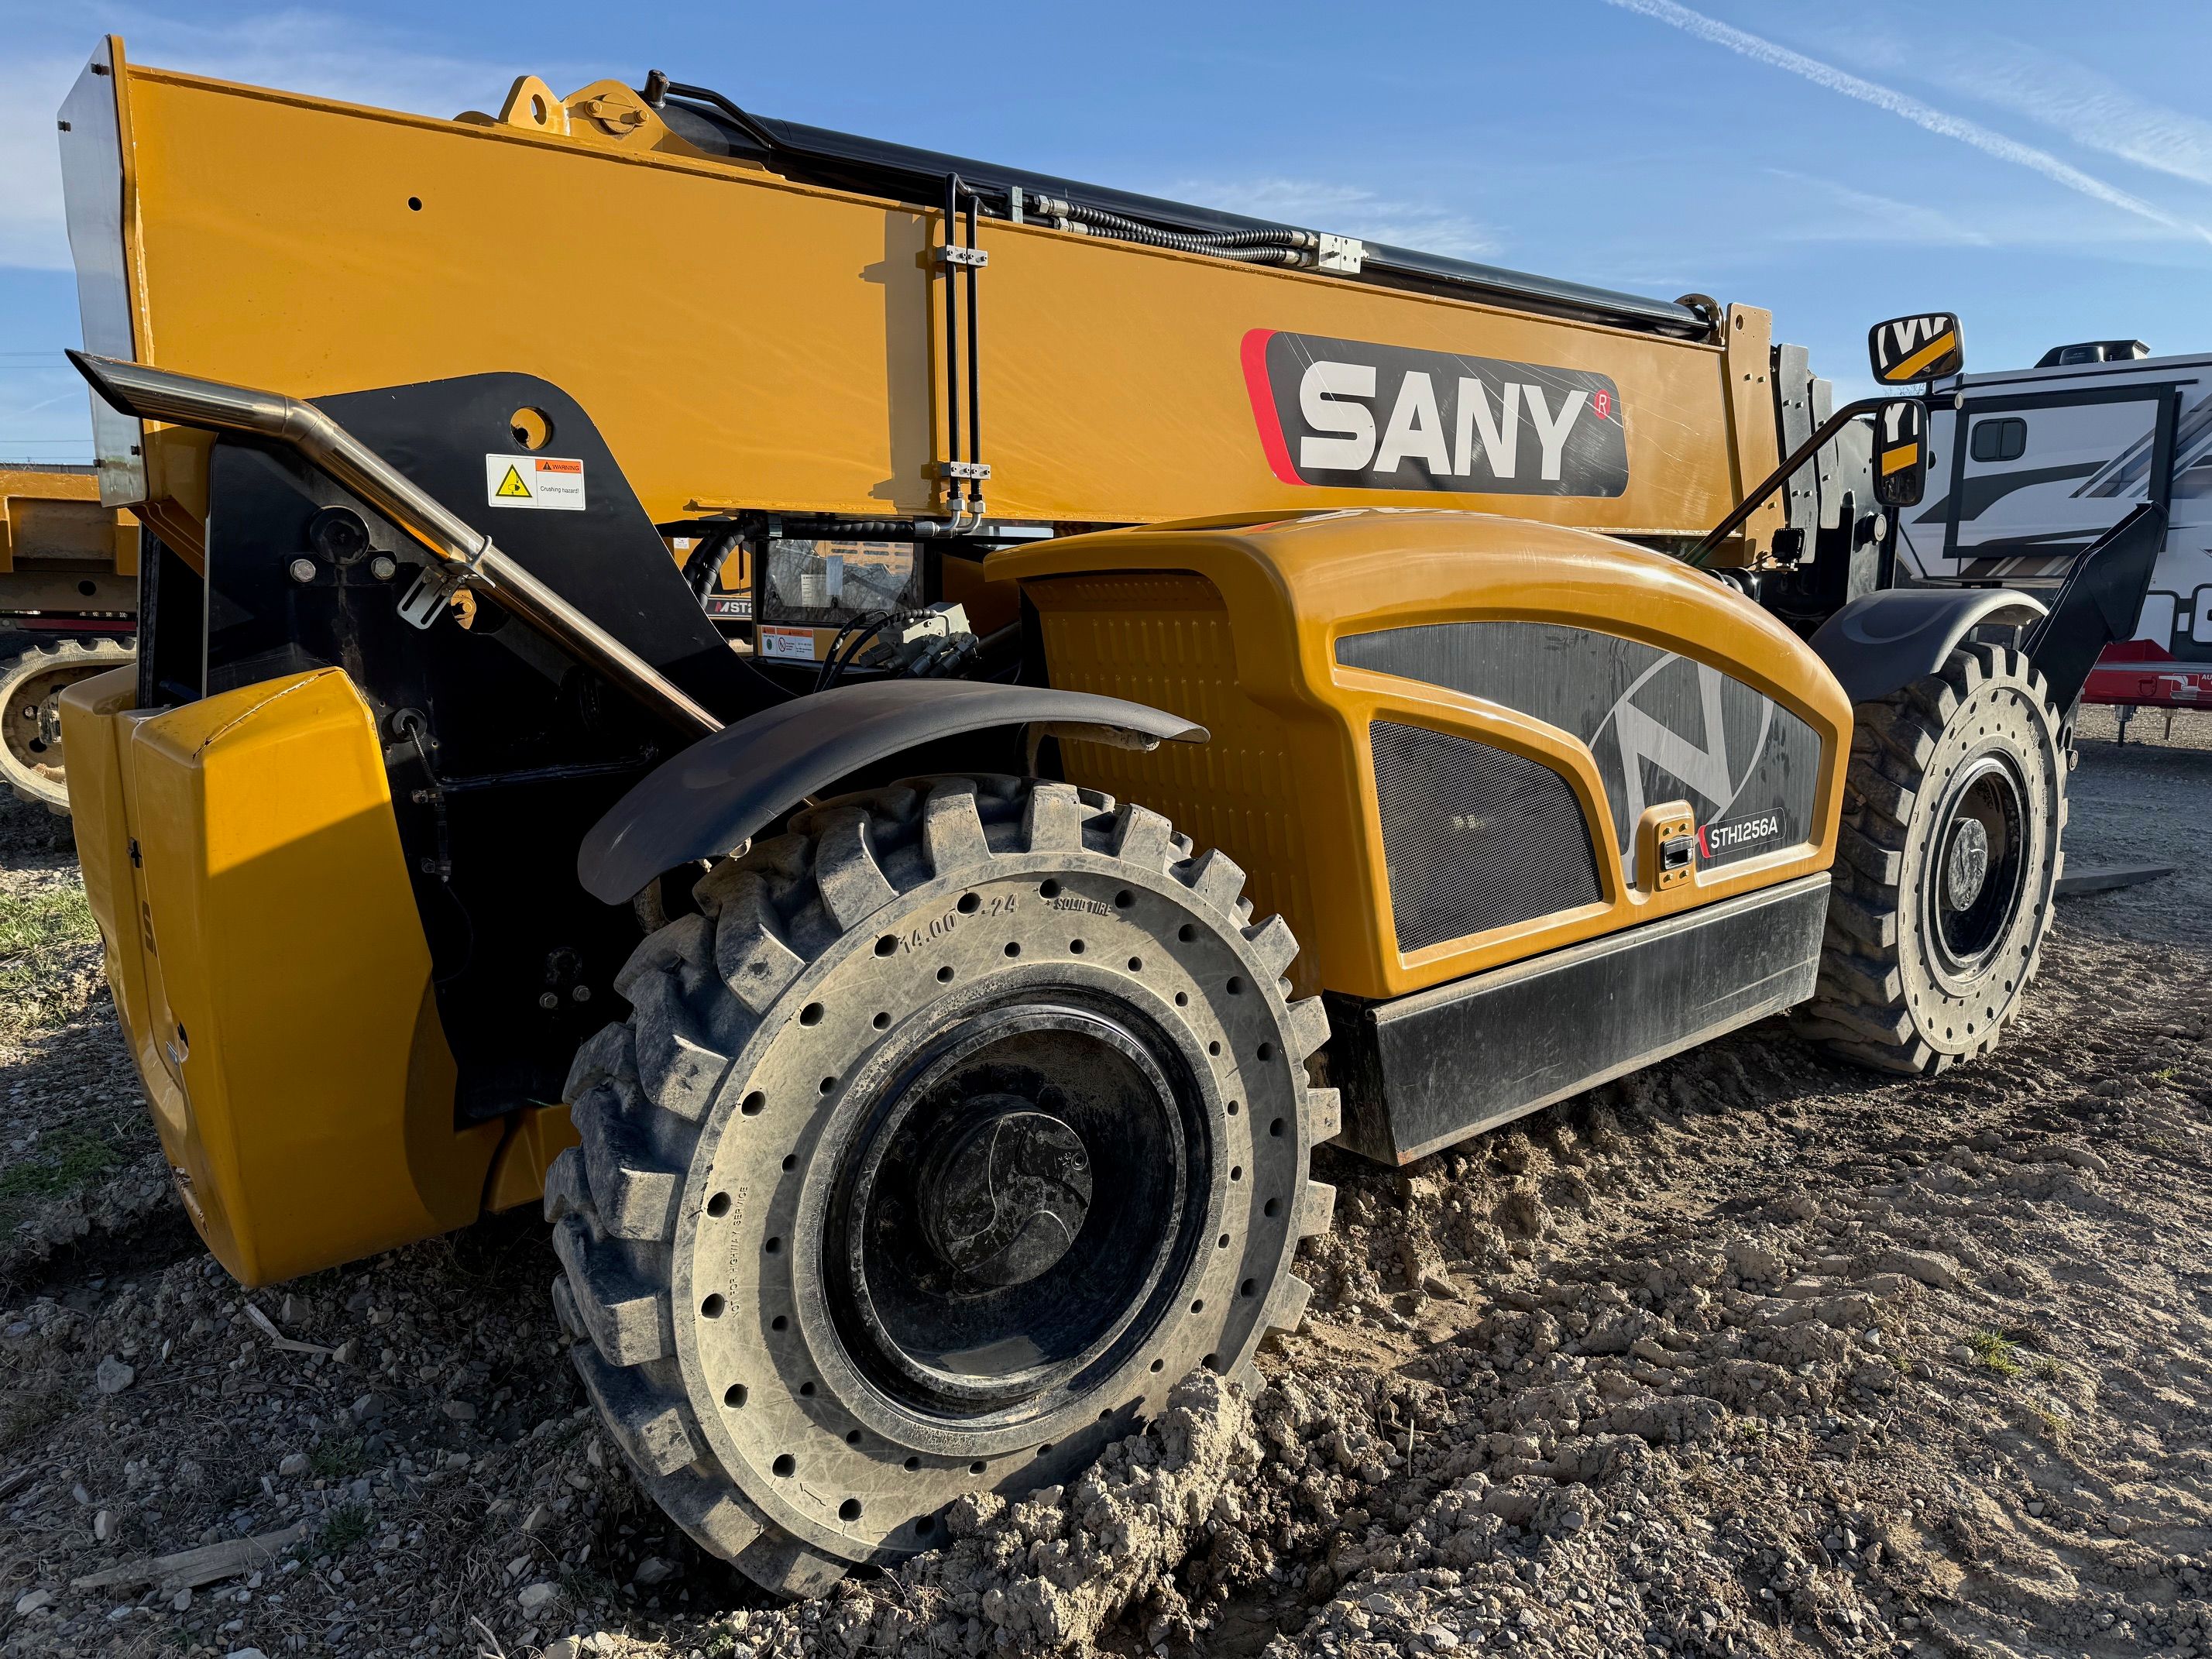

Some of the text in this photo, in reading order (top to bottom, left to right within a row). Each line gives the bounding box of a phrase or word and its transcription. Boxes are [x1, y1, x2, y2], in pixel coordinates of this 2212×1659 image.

[1300, 361, 1589, 480] SANY
[1710, 816, 1778, 849] STH1256A
[1054, 896, 1112, 917] SOLID TIRE
[899, 911, 958, 953] 14.00
